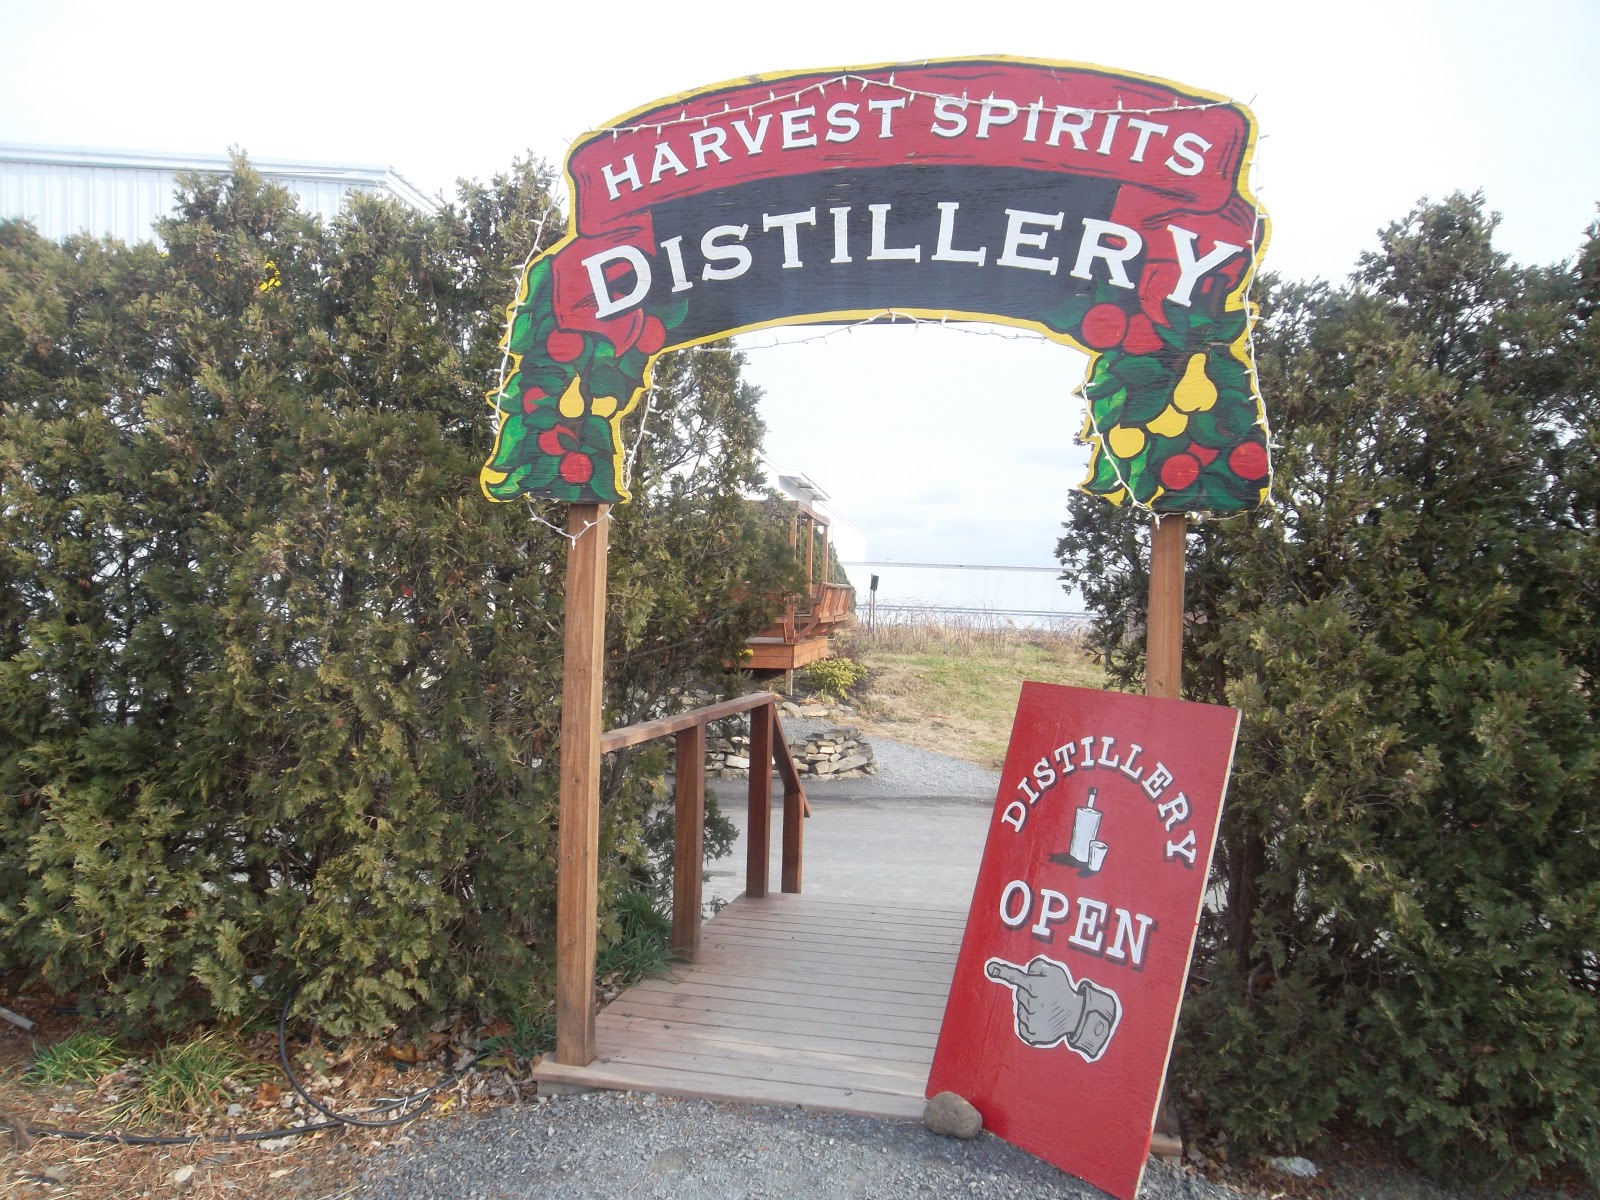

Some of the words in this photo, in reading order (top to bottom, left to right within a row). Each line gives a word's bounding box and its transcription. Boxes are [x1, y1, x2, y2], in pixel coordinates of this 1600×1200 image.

[601, 99, 906, 200] HARVEST
[930, 97, 1213, 176] SPIRITS
[581, 202, 1244, 319] DISTILLERY
[1001, 736, 1197, 864] DISTILLERY
[1000, 880, 1153, 965] OPEN
